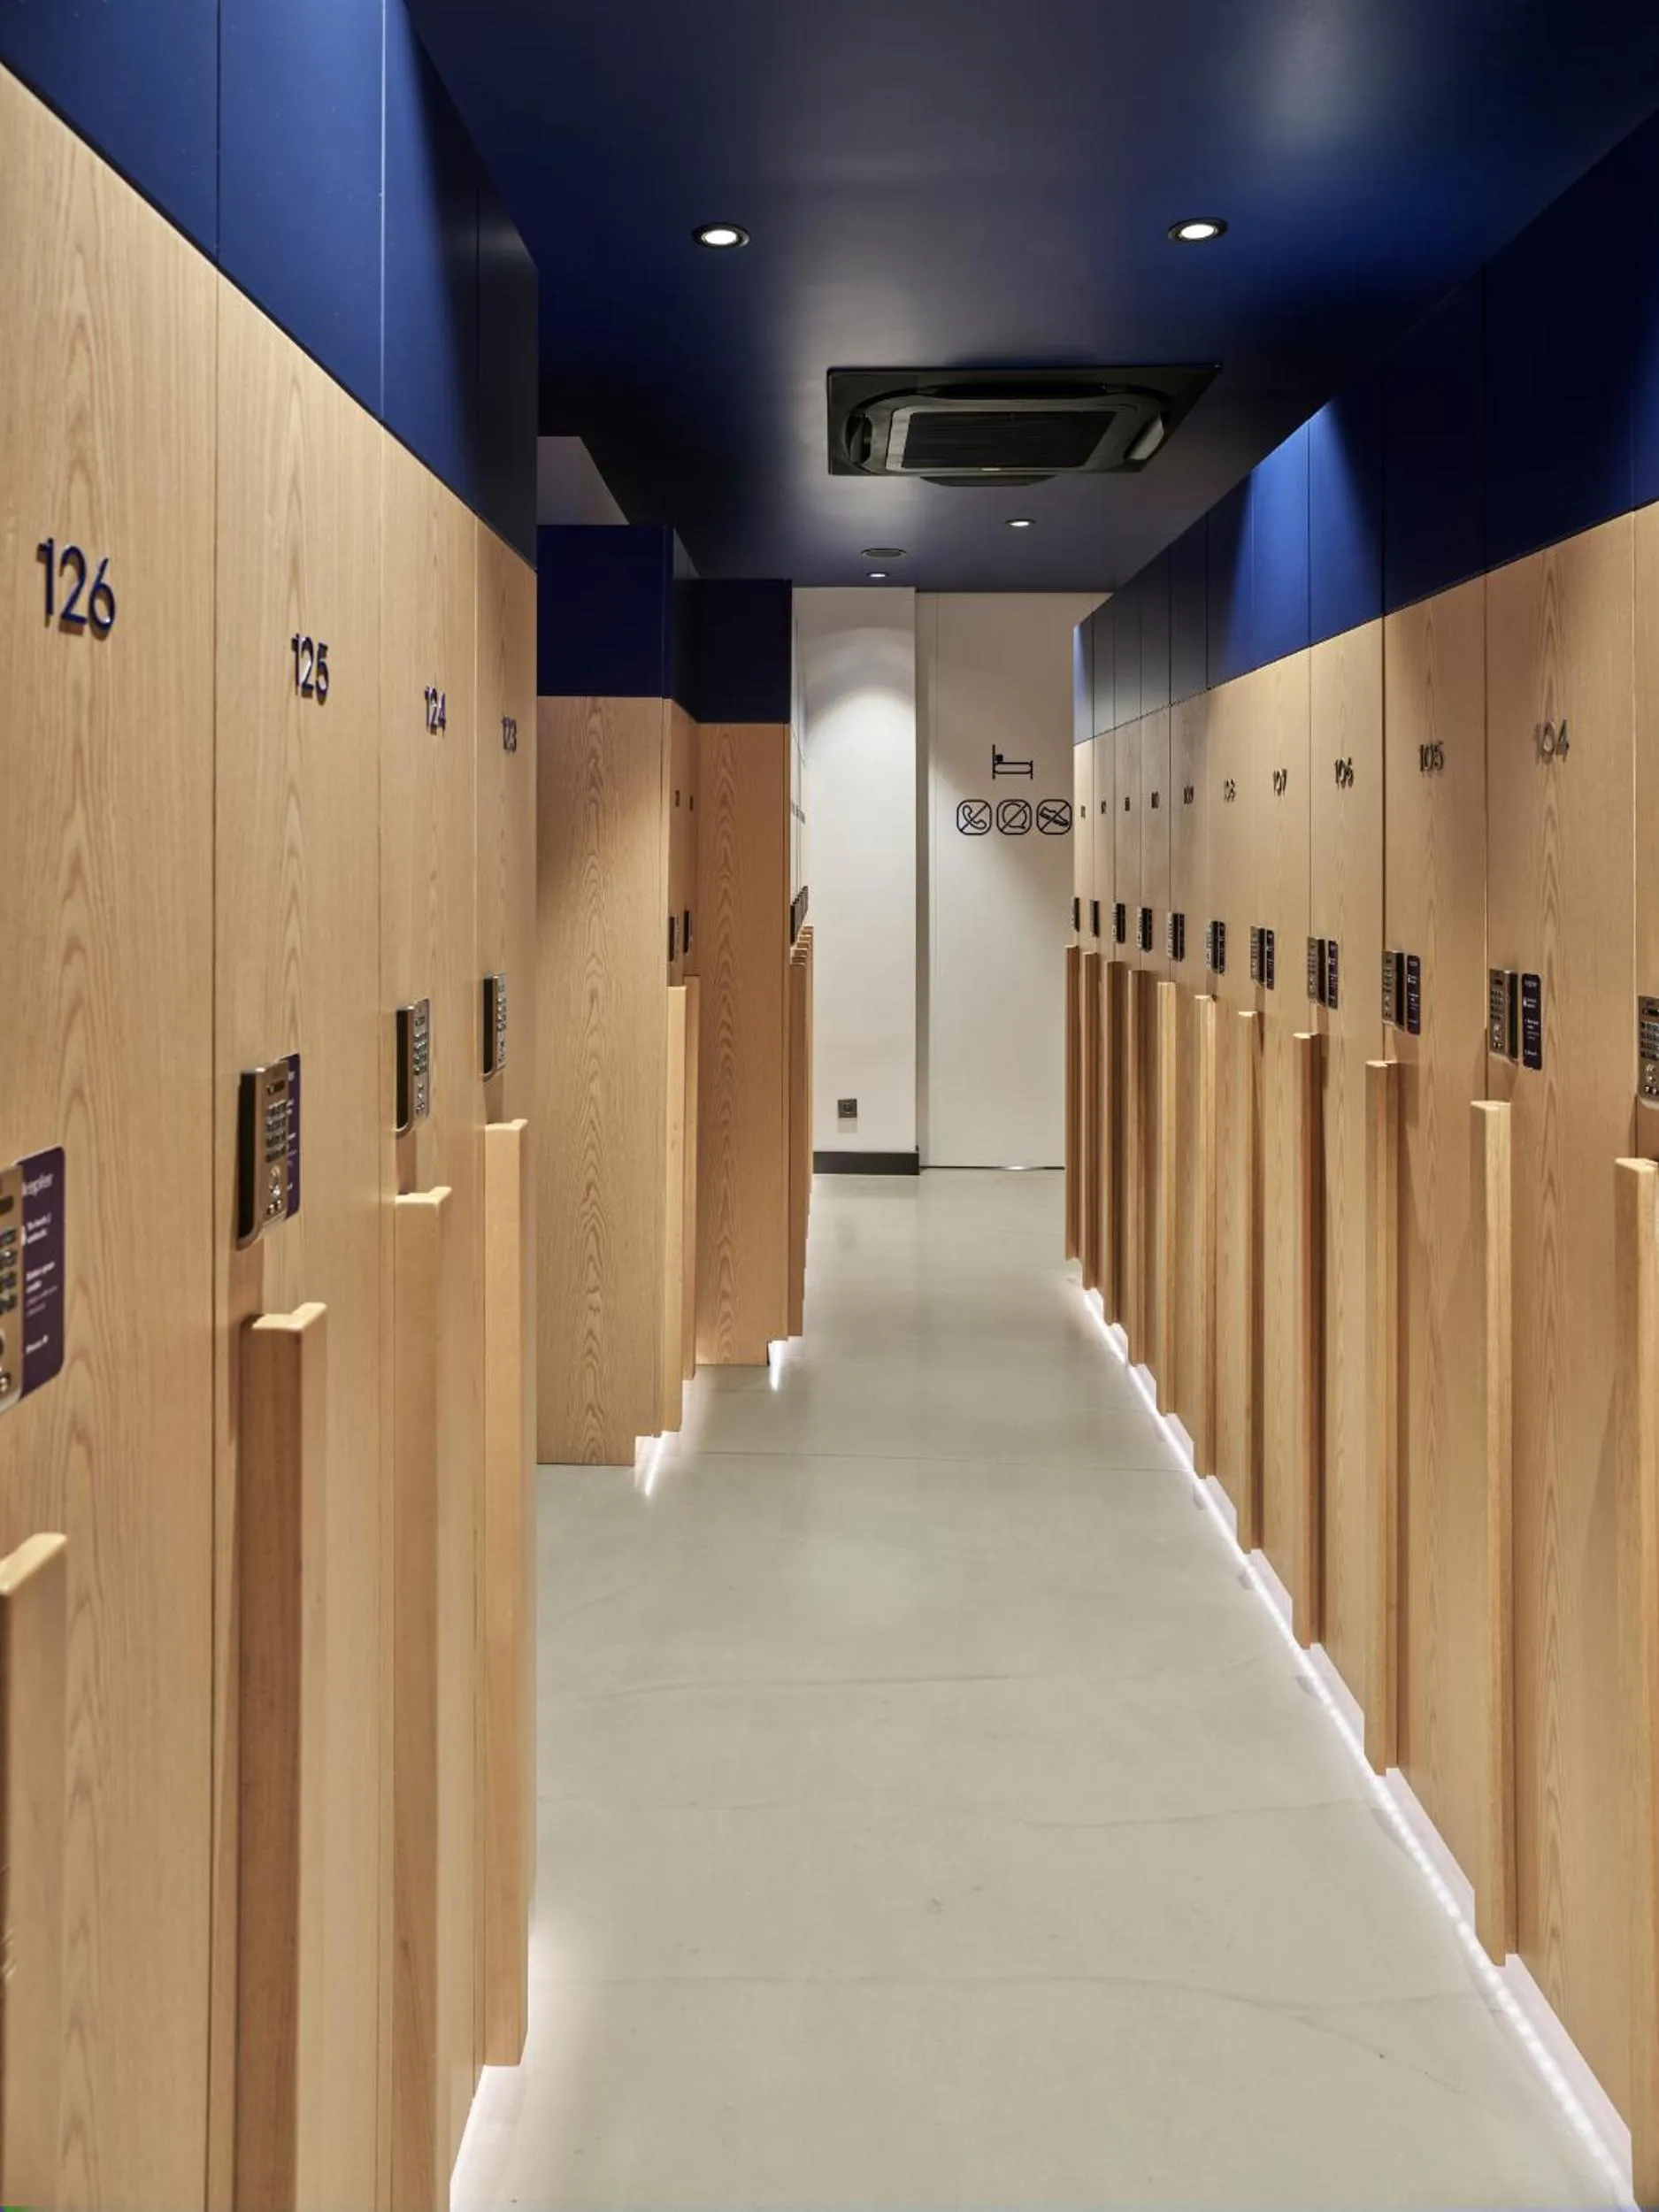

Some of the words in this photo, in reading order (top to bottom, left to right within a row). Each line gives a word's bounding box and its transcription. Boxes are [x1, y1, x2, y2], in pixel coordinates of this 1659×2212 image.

[37, 536, 115, 631] 126
[291, 633, 328, 697] 125
[424, 686, 446, 731] 124
[501, 715, 517, 753] 123
[1534, 719, 1569, 759] 104
[1334, 757, 1354, 787] 106
[1418, 741, 1444, 772] 105
[1272, 769, 1287, 795] 107
